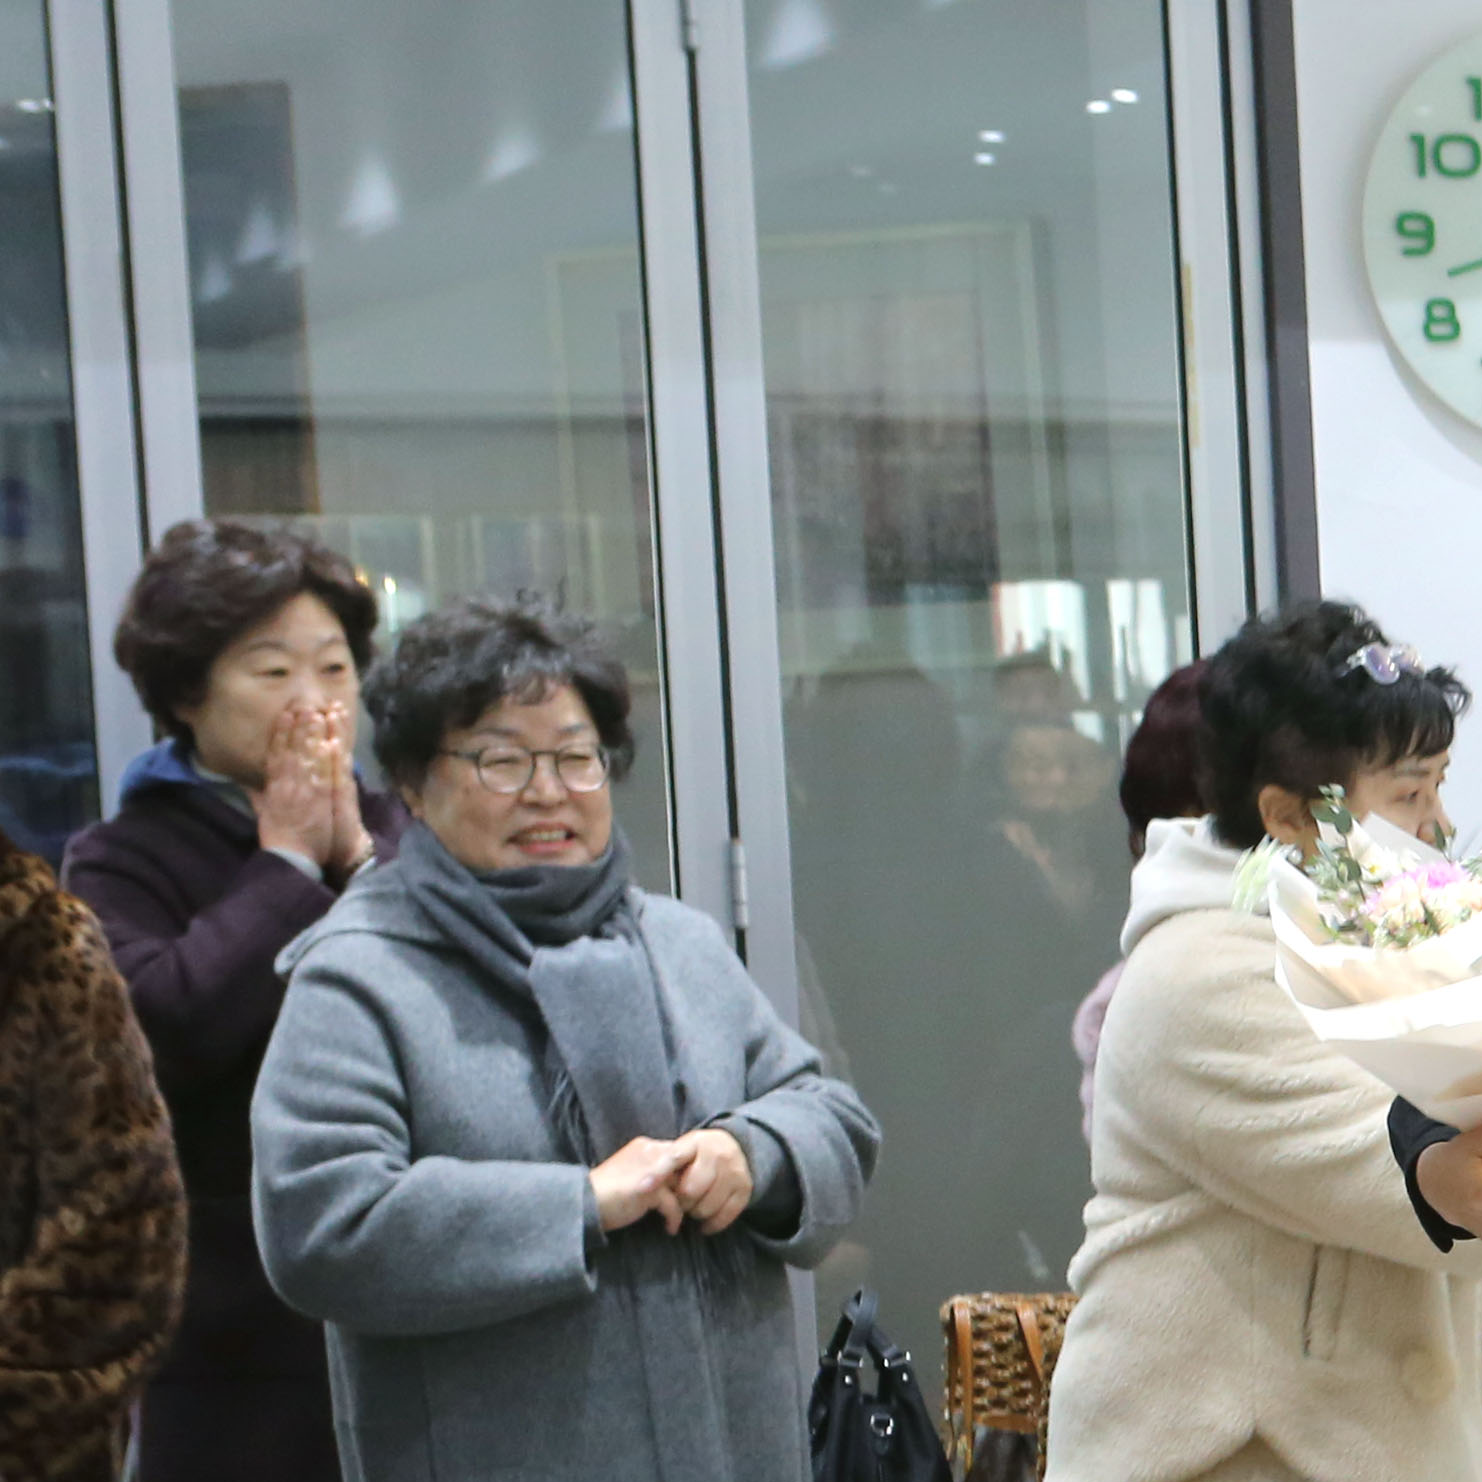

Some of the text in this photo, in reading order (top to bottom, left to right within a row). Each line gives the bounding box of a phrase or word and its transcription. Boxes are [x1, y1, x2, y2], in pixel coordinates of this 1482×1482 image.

[1410, 133, 1482, 178] 10
[1396, 211, 1435, 257] 9
[1423, 298, 1461, 342] 8
